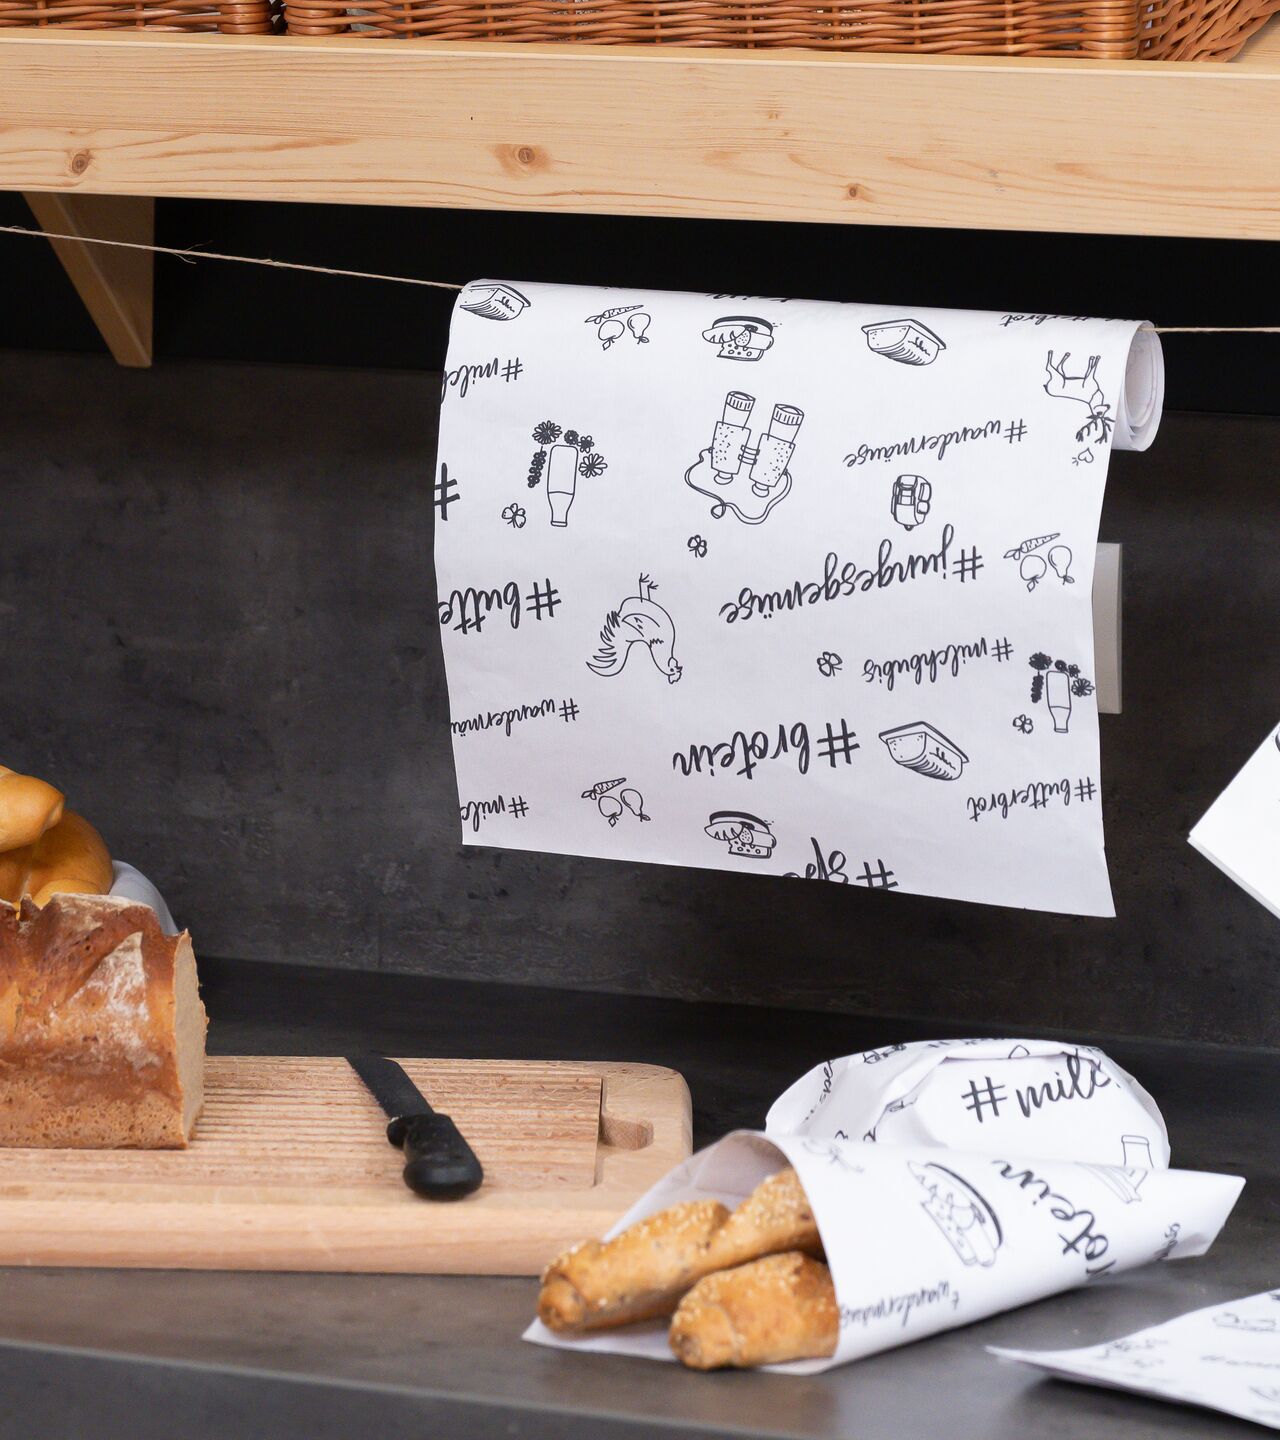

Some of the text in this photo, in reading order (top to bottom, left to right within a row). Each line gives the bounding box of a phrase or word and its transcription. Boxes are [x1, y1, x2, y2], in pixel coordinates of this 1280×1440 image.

[842, 418, 1028, 468] #wandermäuse
[718, 521, 984, 624] #jungesgemüse
[861, 636, 1014, 692] #milchbubis
[672, 718, 860, 780] #brotein
[966, 775, 1097, 822] #butterbrot
[782, 837, 899, 891] #sp
